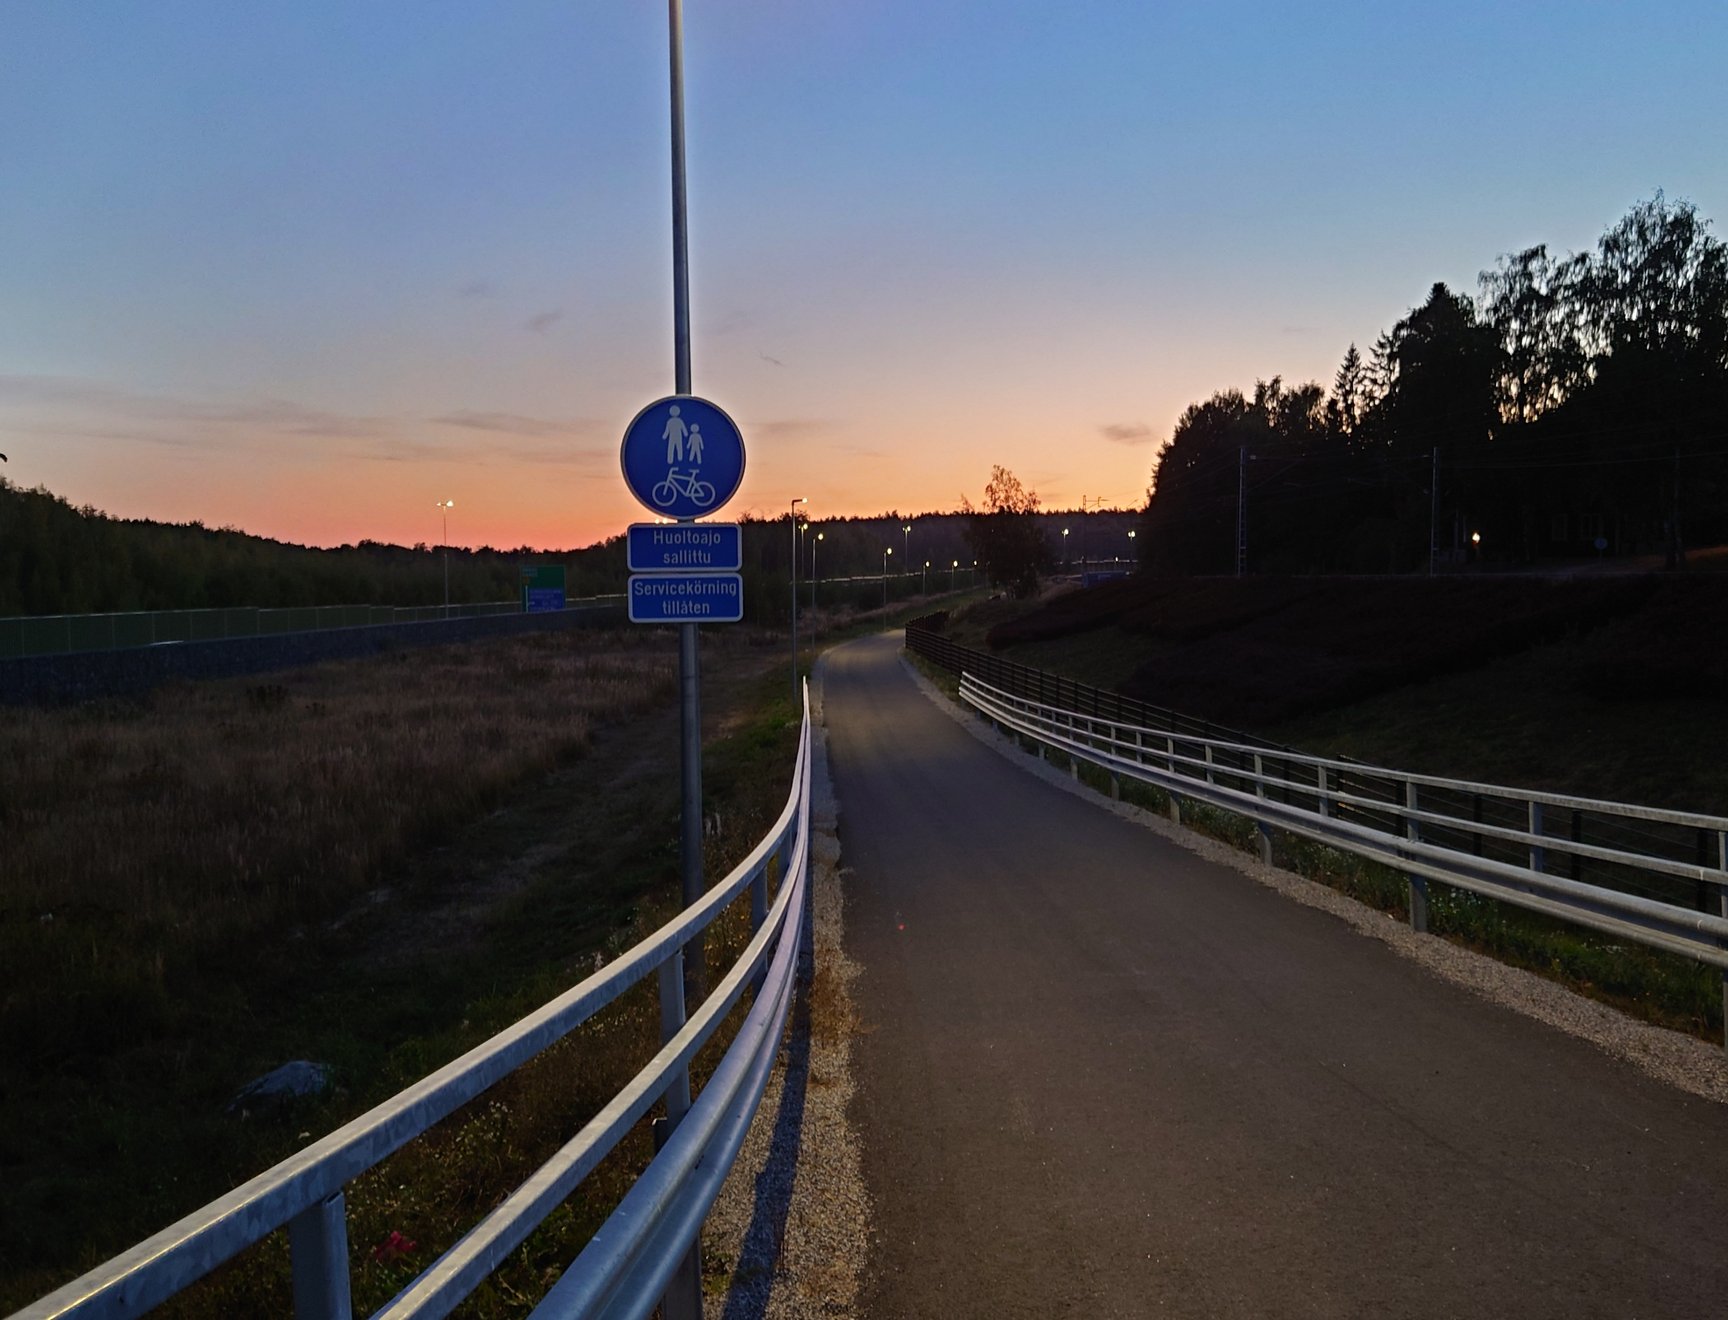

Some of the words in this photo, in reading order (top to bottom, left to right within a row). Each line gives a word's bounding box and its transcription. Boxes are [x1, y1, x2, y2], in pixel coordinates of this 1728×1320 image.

[653, 530, 721, 546] Huoltoajo
[663, 550, 711, 564] sallittu
[634, 580, 737, 597] Servicekörning
[662, 601, 710, 615] tillåten
